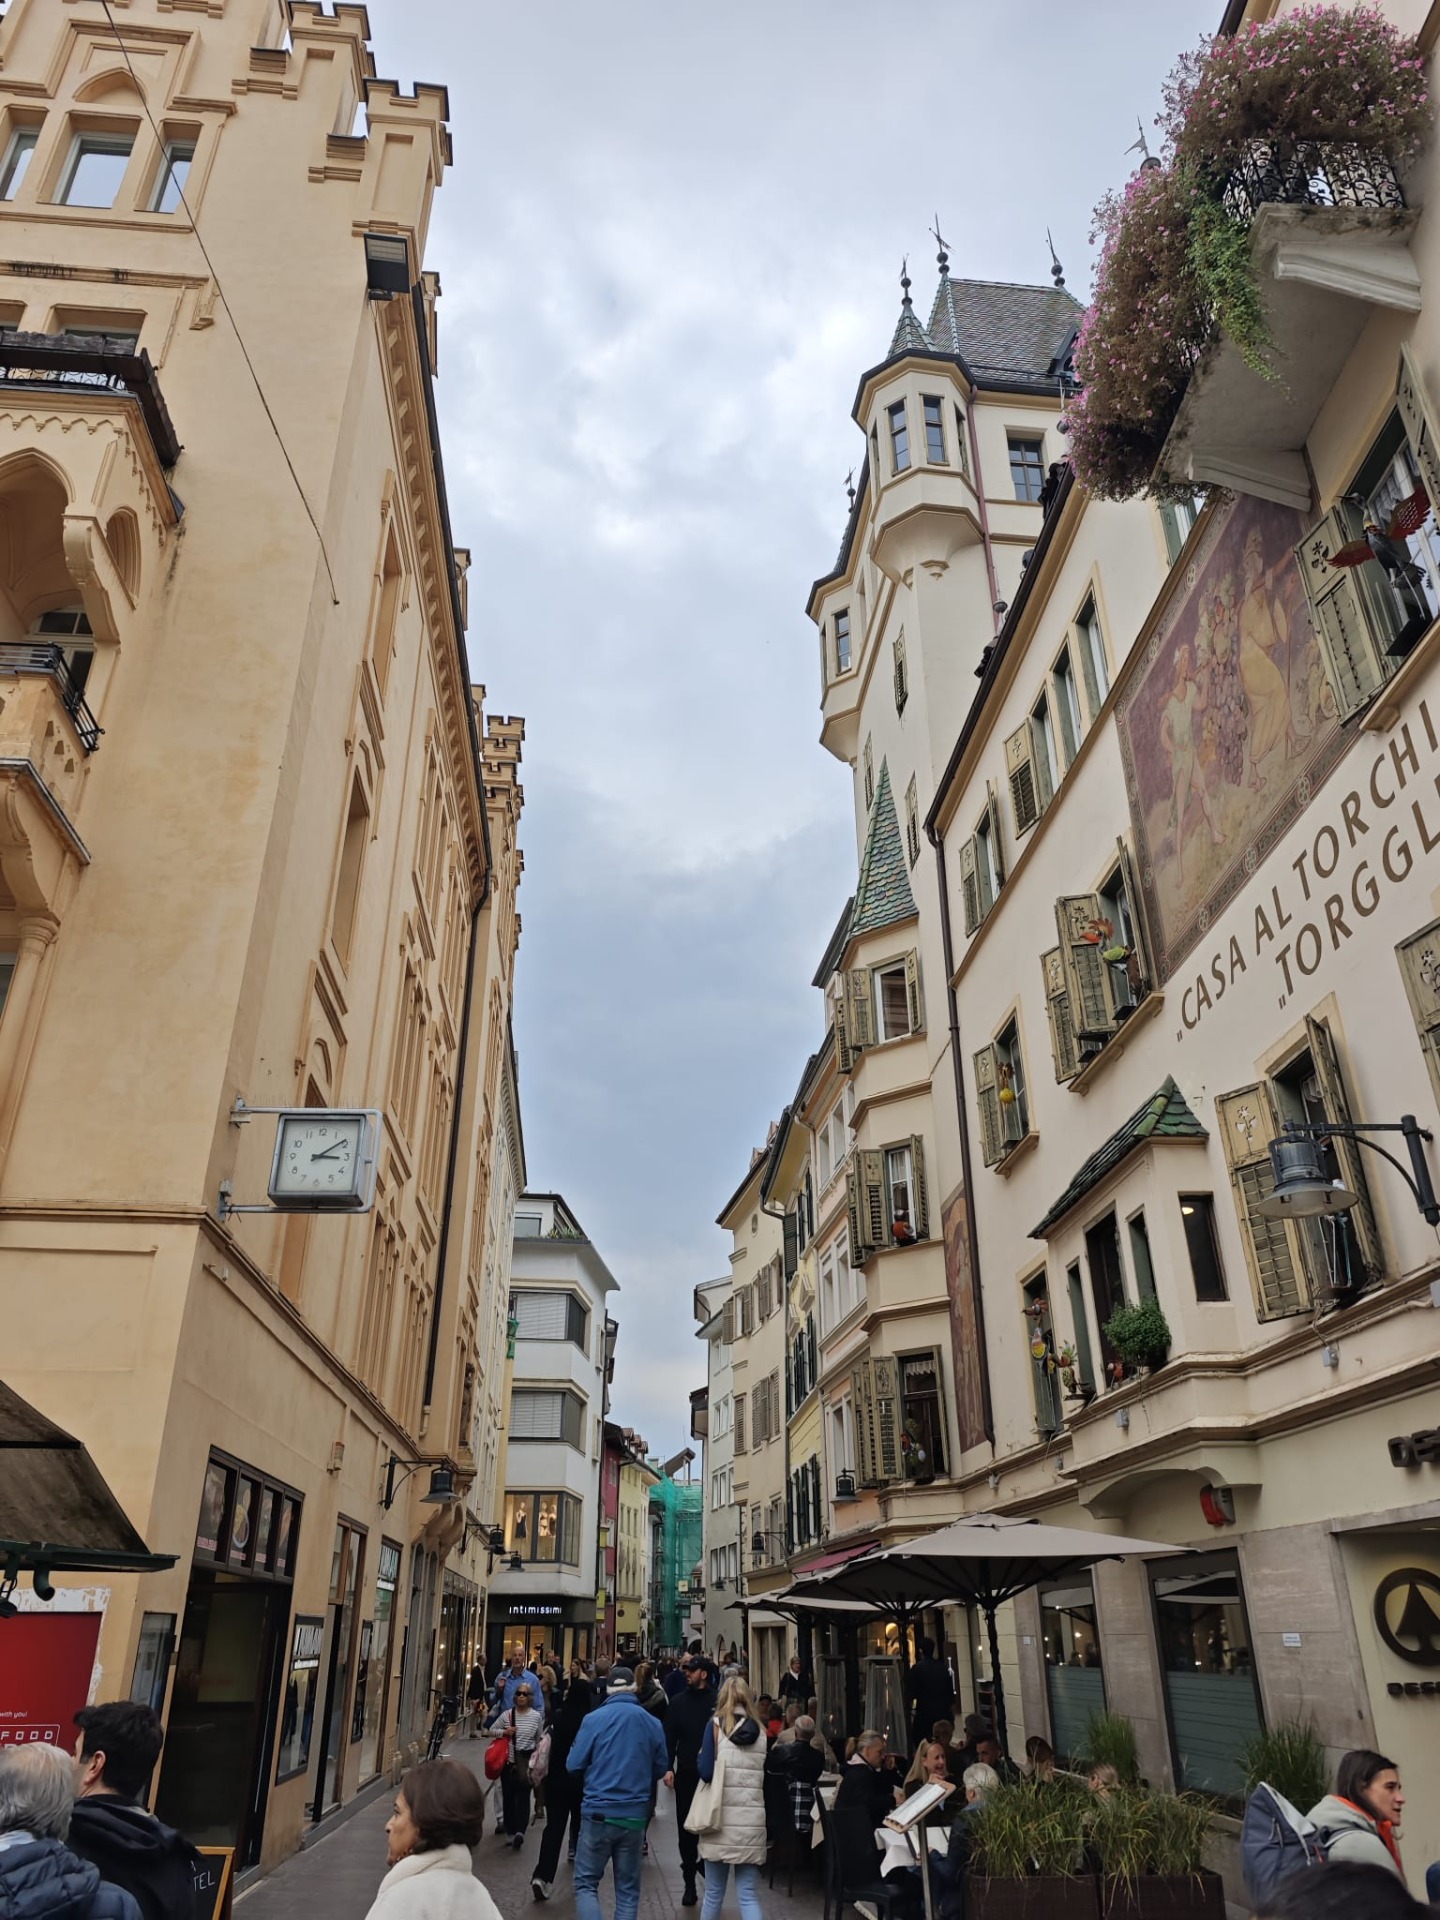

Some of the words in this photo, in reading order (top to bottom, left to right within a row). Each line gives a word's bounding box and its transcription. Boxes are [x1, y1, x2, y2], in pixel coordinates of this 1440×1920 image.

[1254, 885, 1292, 956] AL
[306, 1130, 313, 1139] 11
[319, 1128, 328, 1136] 12
[294, 1140, 303, 1148] 10
[343, 1153, 350, 1161] 3
[291, 1166, 298, 1174] 8
[338, 1166, 344, 1174] 4
[301, 1174, 307, 1183] 7
[328, 1174, 334, 1183] 5
[313, 1179, 320, 1187] 6
[509, 1605, 562, 1615] intimissimi
[13, 1711, 27, 1719] you!
[1, 1731, 53, 1740] FOOD
